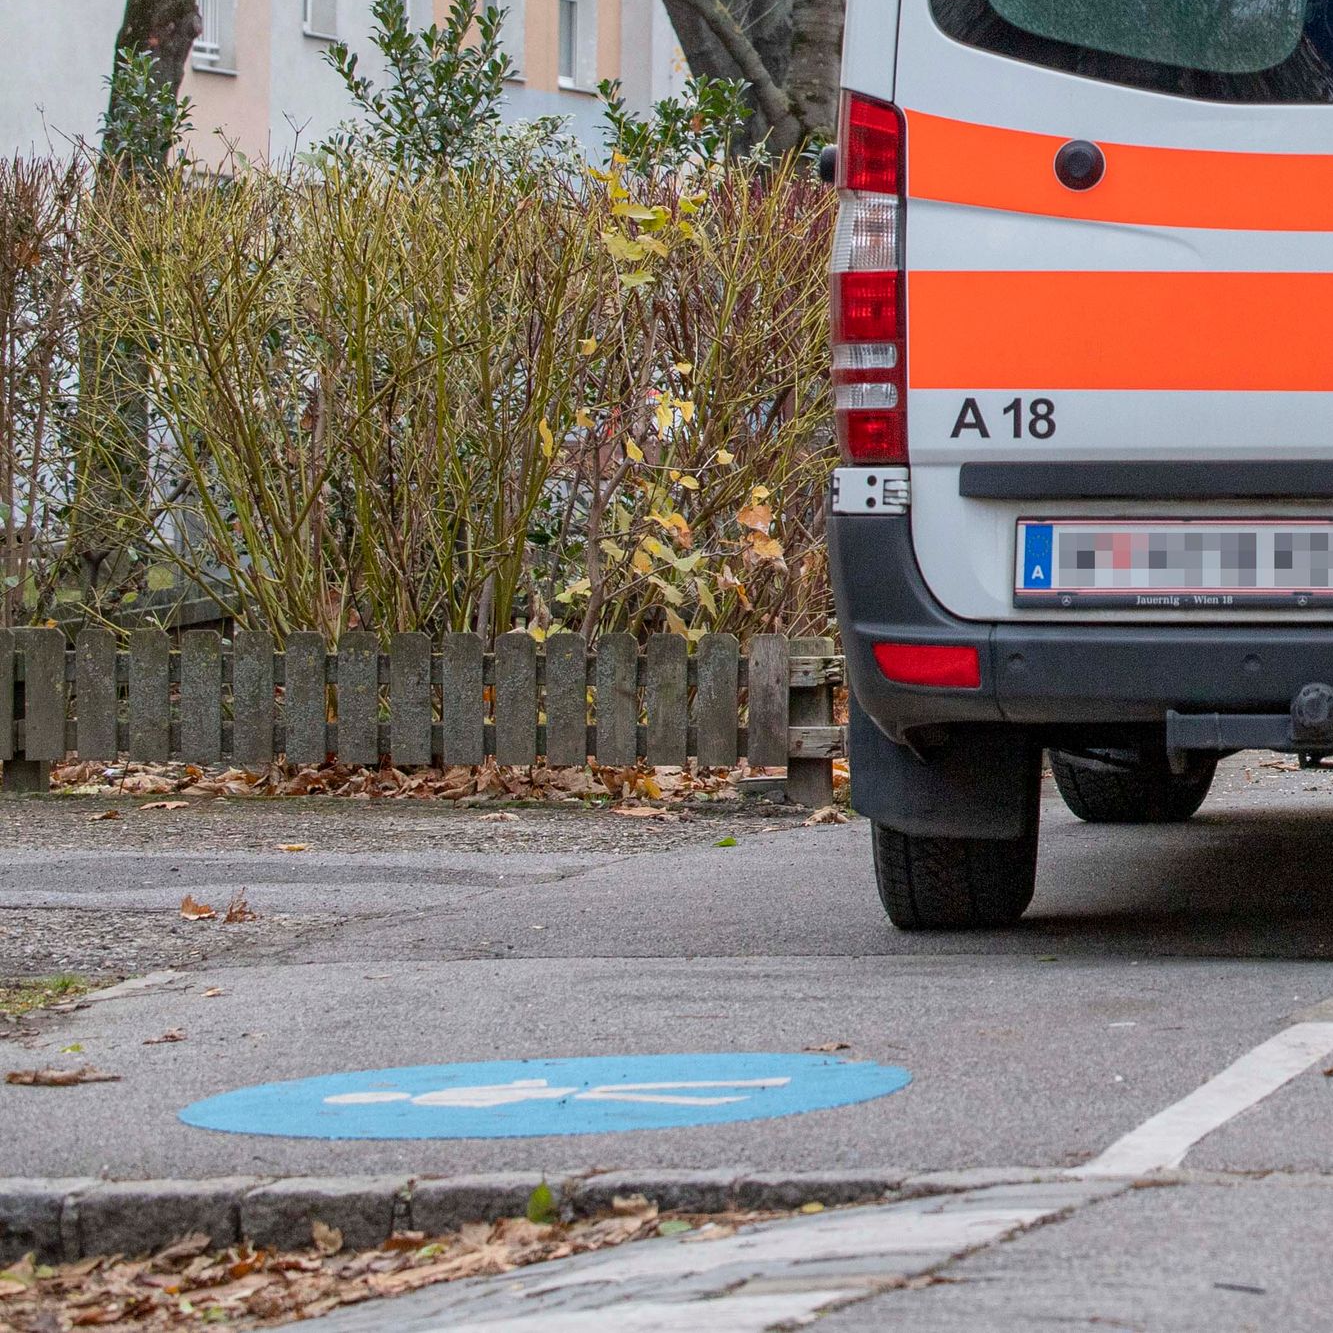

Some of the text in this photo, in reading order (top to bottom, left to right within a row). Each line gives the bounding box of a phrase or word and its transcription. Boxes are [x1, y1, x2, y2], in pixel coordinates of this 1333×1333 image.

[949, 397, 1057, 440] A 18
[1031, 565, 1045, 580] A
[1193, 595, 1219, 605] Wien
[1222, 595, 1234, 605] 18
